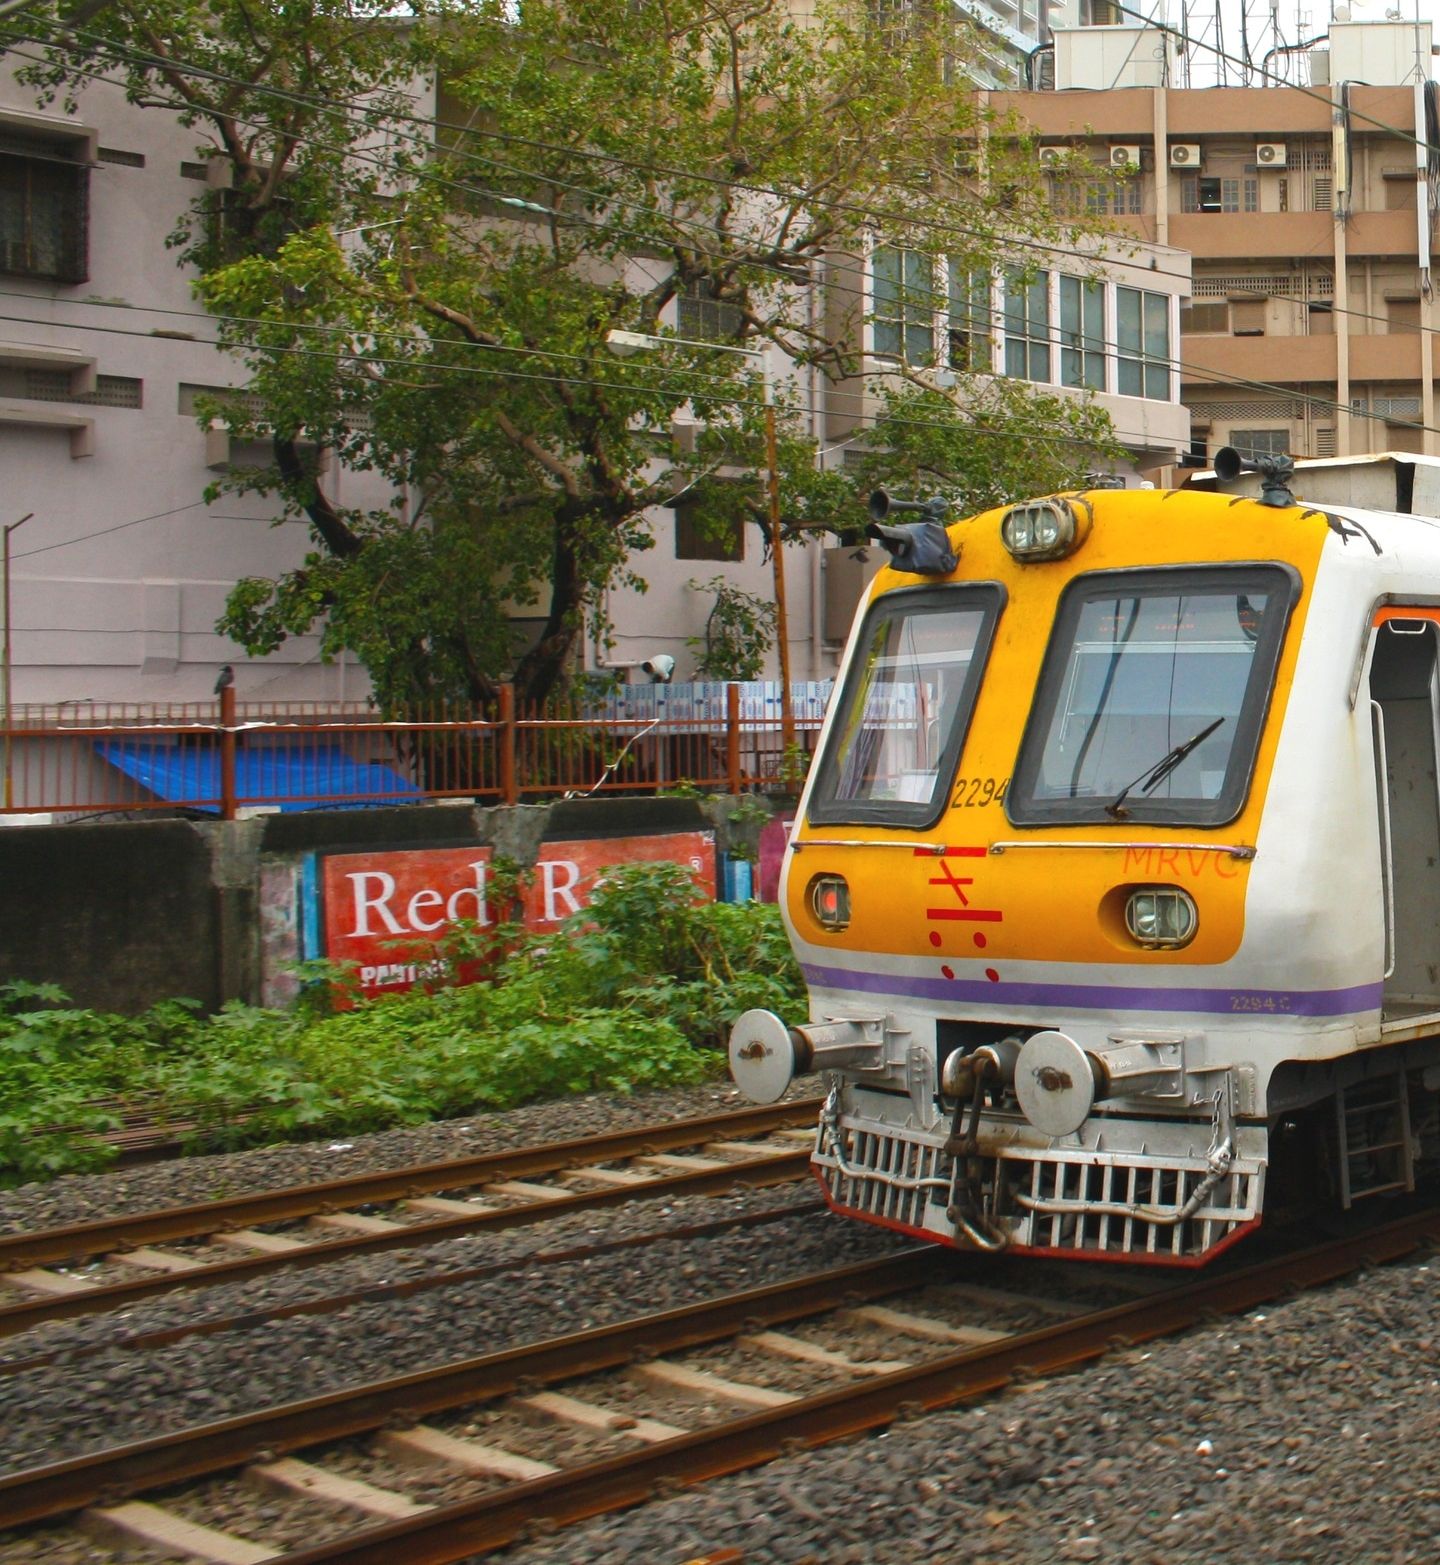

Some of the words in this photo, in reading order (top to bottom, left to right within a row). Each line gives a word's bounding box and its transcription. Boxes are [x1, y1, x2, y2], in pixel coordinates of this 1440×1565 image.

[951, 778, 1010, 808] 2294
[1122, 846, 1239, 878] MRVC
[345, 860, 493, 938] Red
